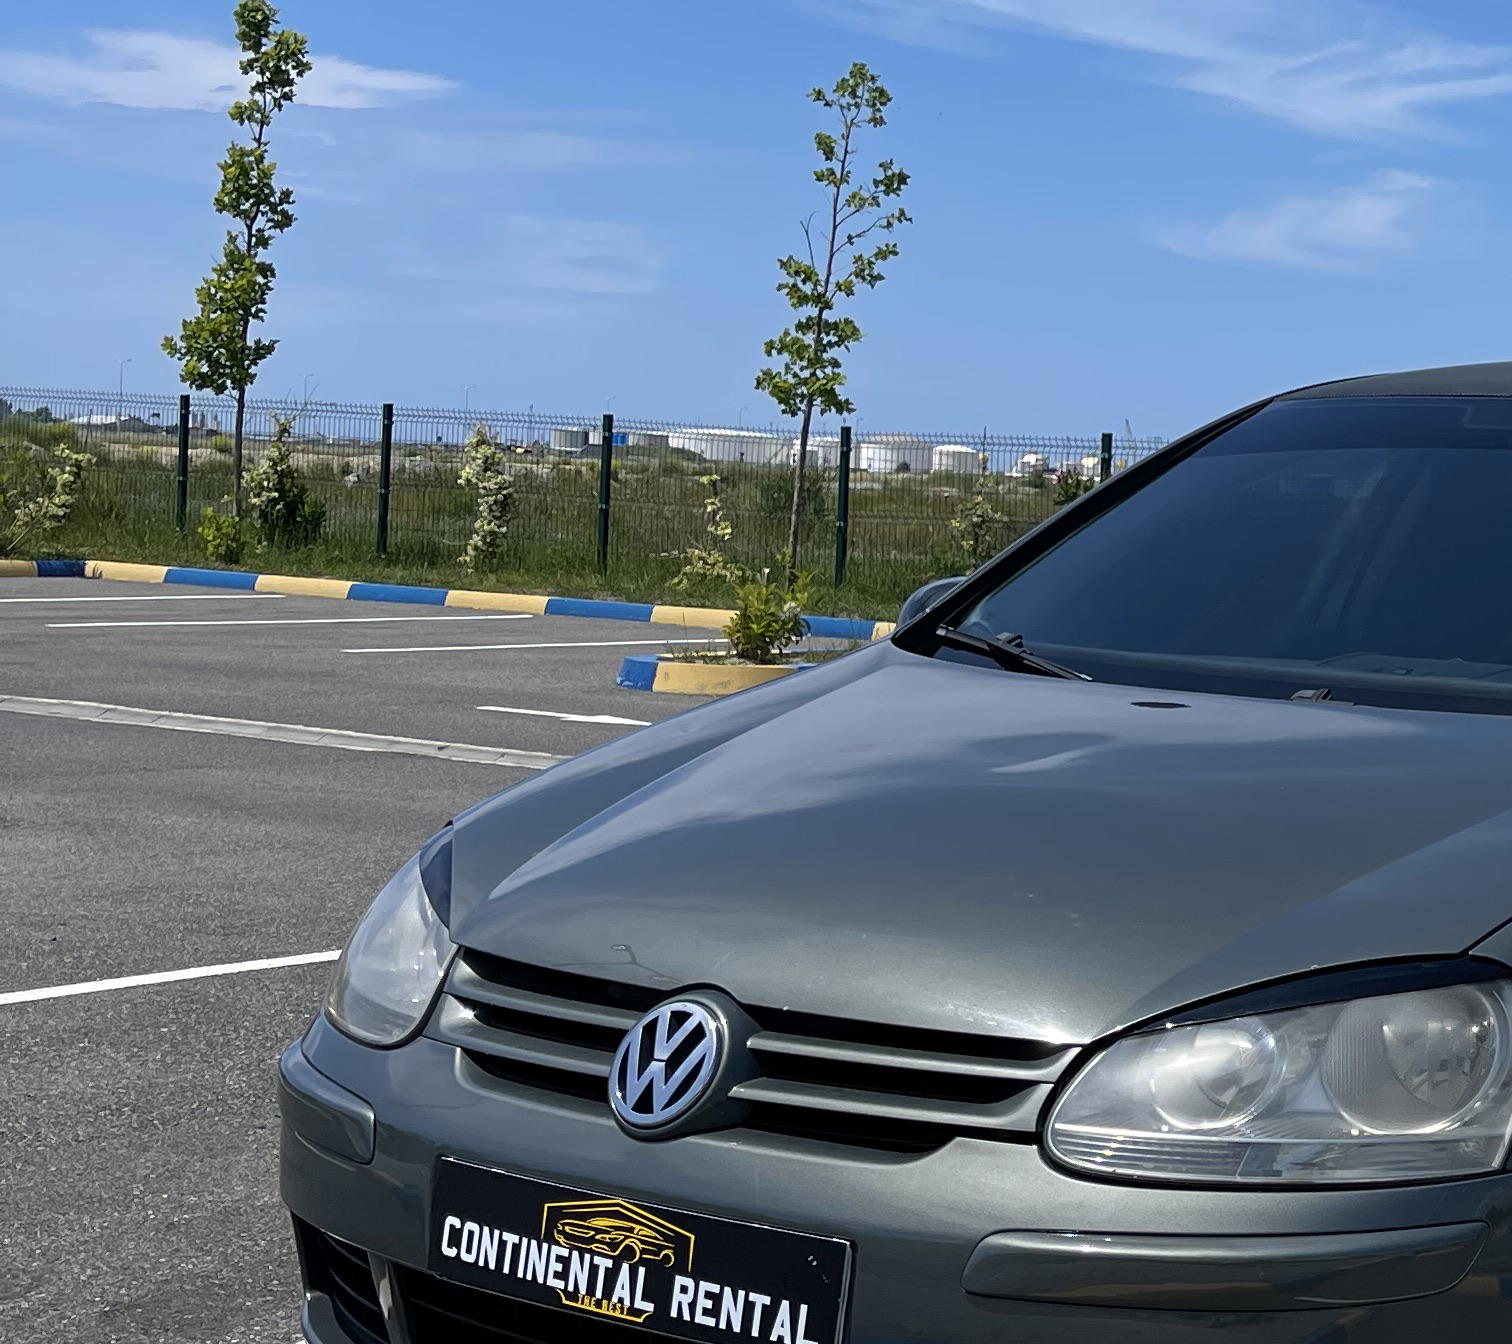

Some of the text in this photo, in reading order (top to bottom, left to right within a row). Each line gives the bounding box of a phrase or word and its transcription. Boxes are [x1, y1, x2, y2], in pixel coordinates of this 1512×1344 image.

[613, 1002, 716, 1124] VW
[440, 1215, 655, 1313] CONTINENTAL
[578, 1293, 597, 1309] THE
